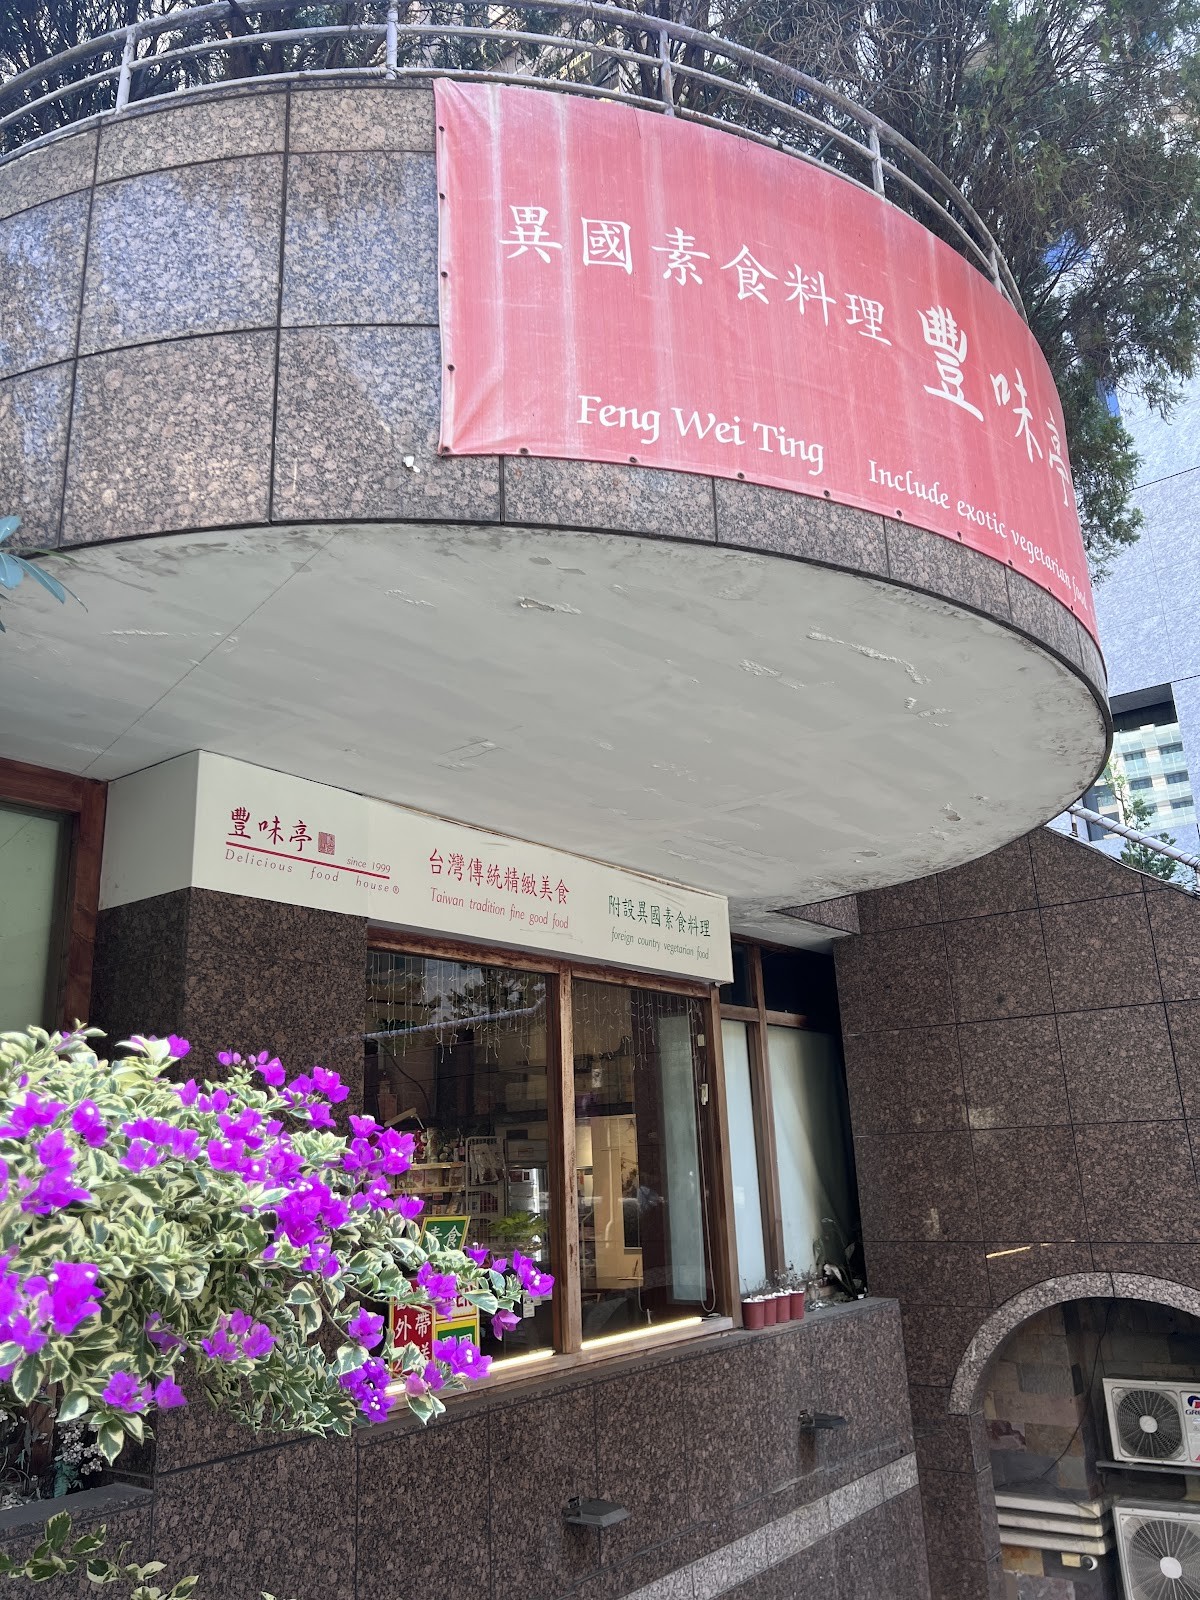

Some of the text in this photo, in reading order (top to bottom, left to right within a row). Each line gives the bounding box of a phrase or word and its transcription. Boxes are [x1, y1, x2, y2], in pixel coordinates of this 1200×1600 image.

[498, 204, 1072, 508] 異國素食料理 豐味亭
[577, 395, 662, 446] Feng
[671, 406, 745, 447] Wei
[752, 422, 825, 476] Ting
[868, 459, 951, 510] Include
[957, 500, 1007, 538] exotic
[1011, 529, 1072, 589] vegetarian
[227, 806, 313, 852] 豐味亭
[224, 848, 294, 873] Delicious
[310, 866, 339, 882] food
[346, 856, 391, 874] since 1999
[429, 848, 571, 905] 台灣傳統精緻美食
[430, 886, 569, 930] Taiwan tradition fine good food
[608, 894, 711, 937] 附設異國素食料理
[611, 926, 710, 961] foreign country vegetarian food
[394, 1311, 432, 1342] 外帶
